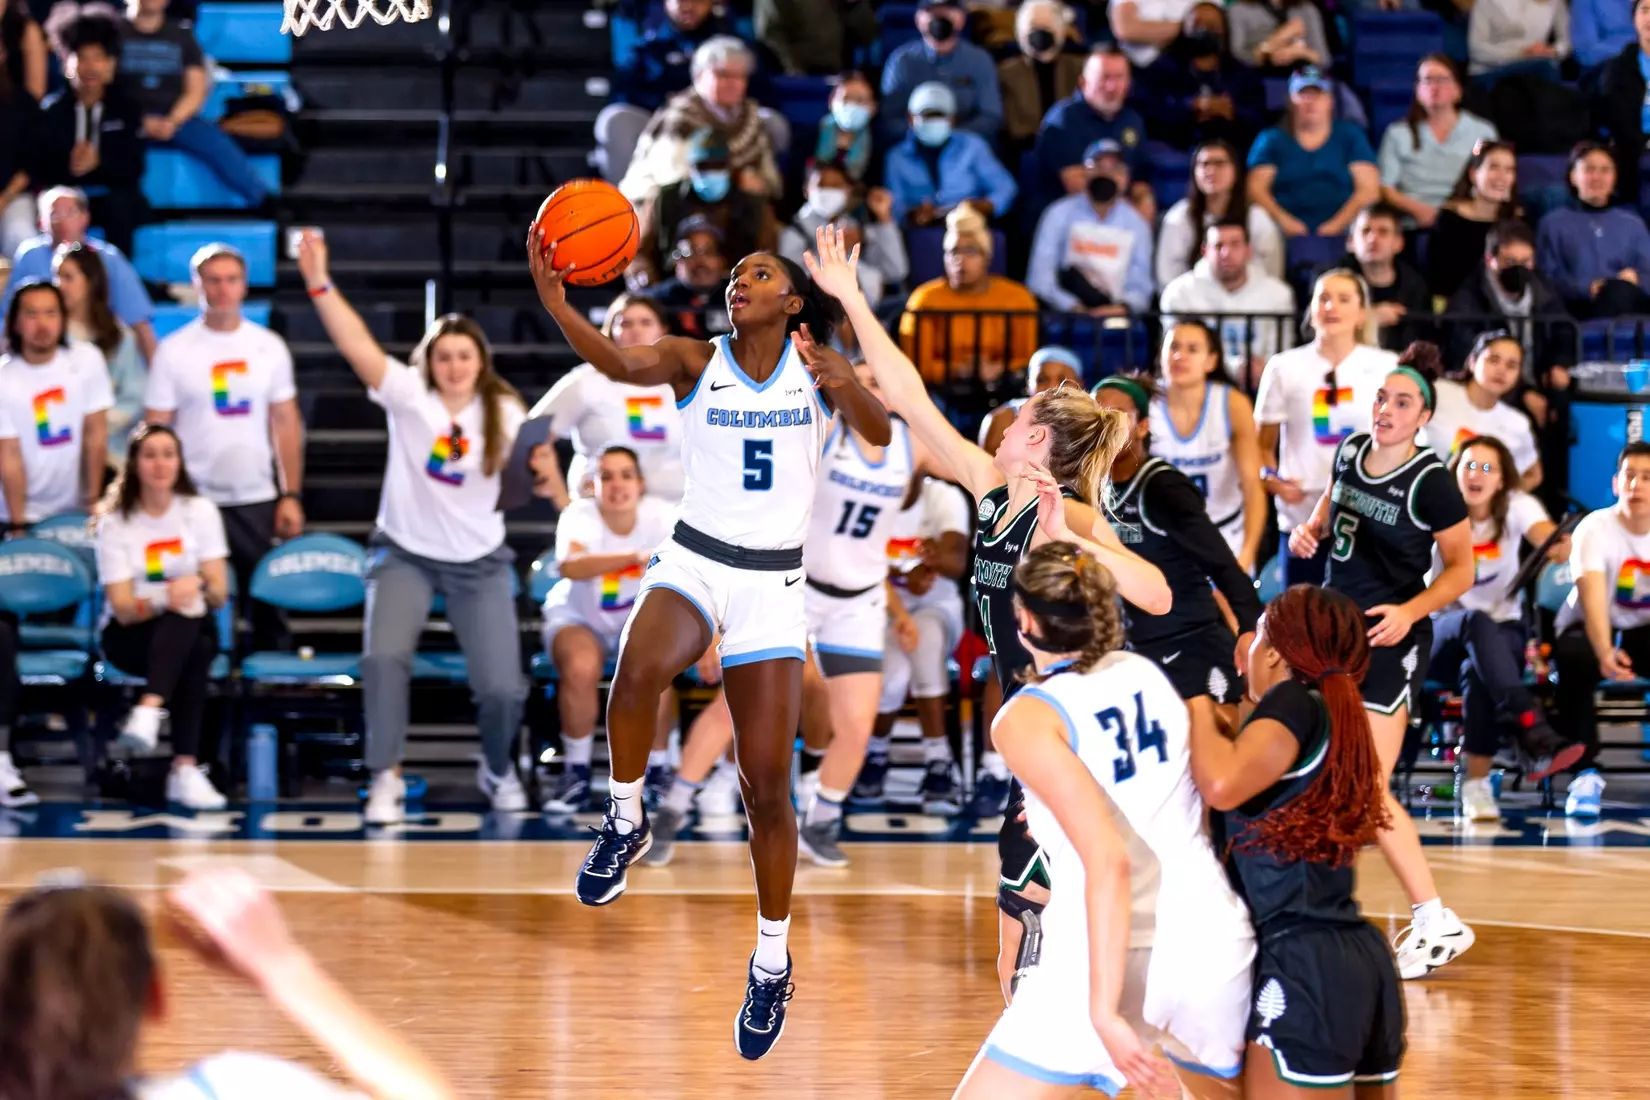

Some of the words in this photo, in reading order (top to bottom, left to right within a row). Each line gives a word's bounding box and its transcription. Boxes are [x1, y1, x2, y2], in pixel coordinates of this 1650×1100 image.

[211, 361, 251, 416] C
[33, 386, 73, 447] C
[625, 396, 667, 440] C
[707, 407, 813, 428] COLUMBIA
[743, 438, 774, 491] 5
[835, 499, 881, 538] 15
[1331, 511, 1359, 562] 5
[1094, 690, 1168, 784] 34
